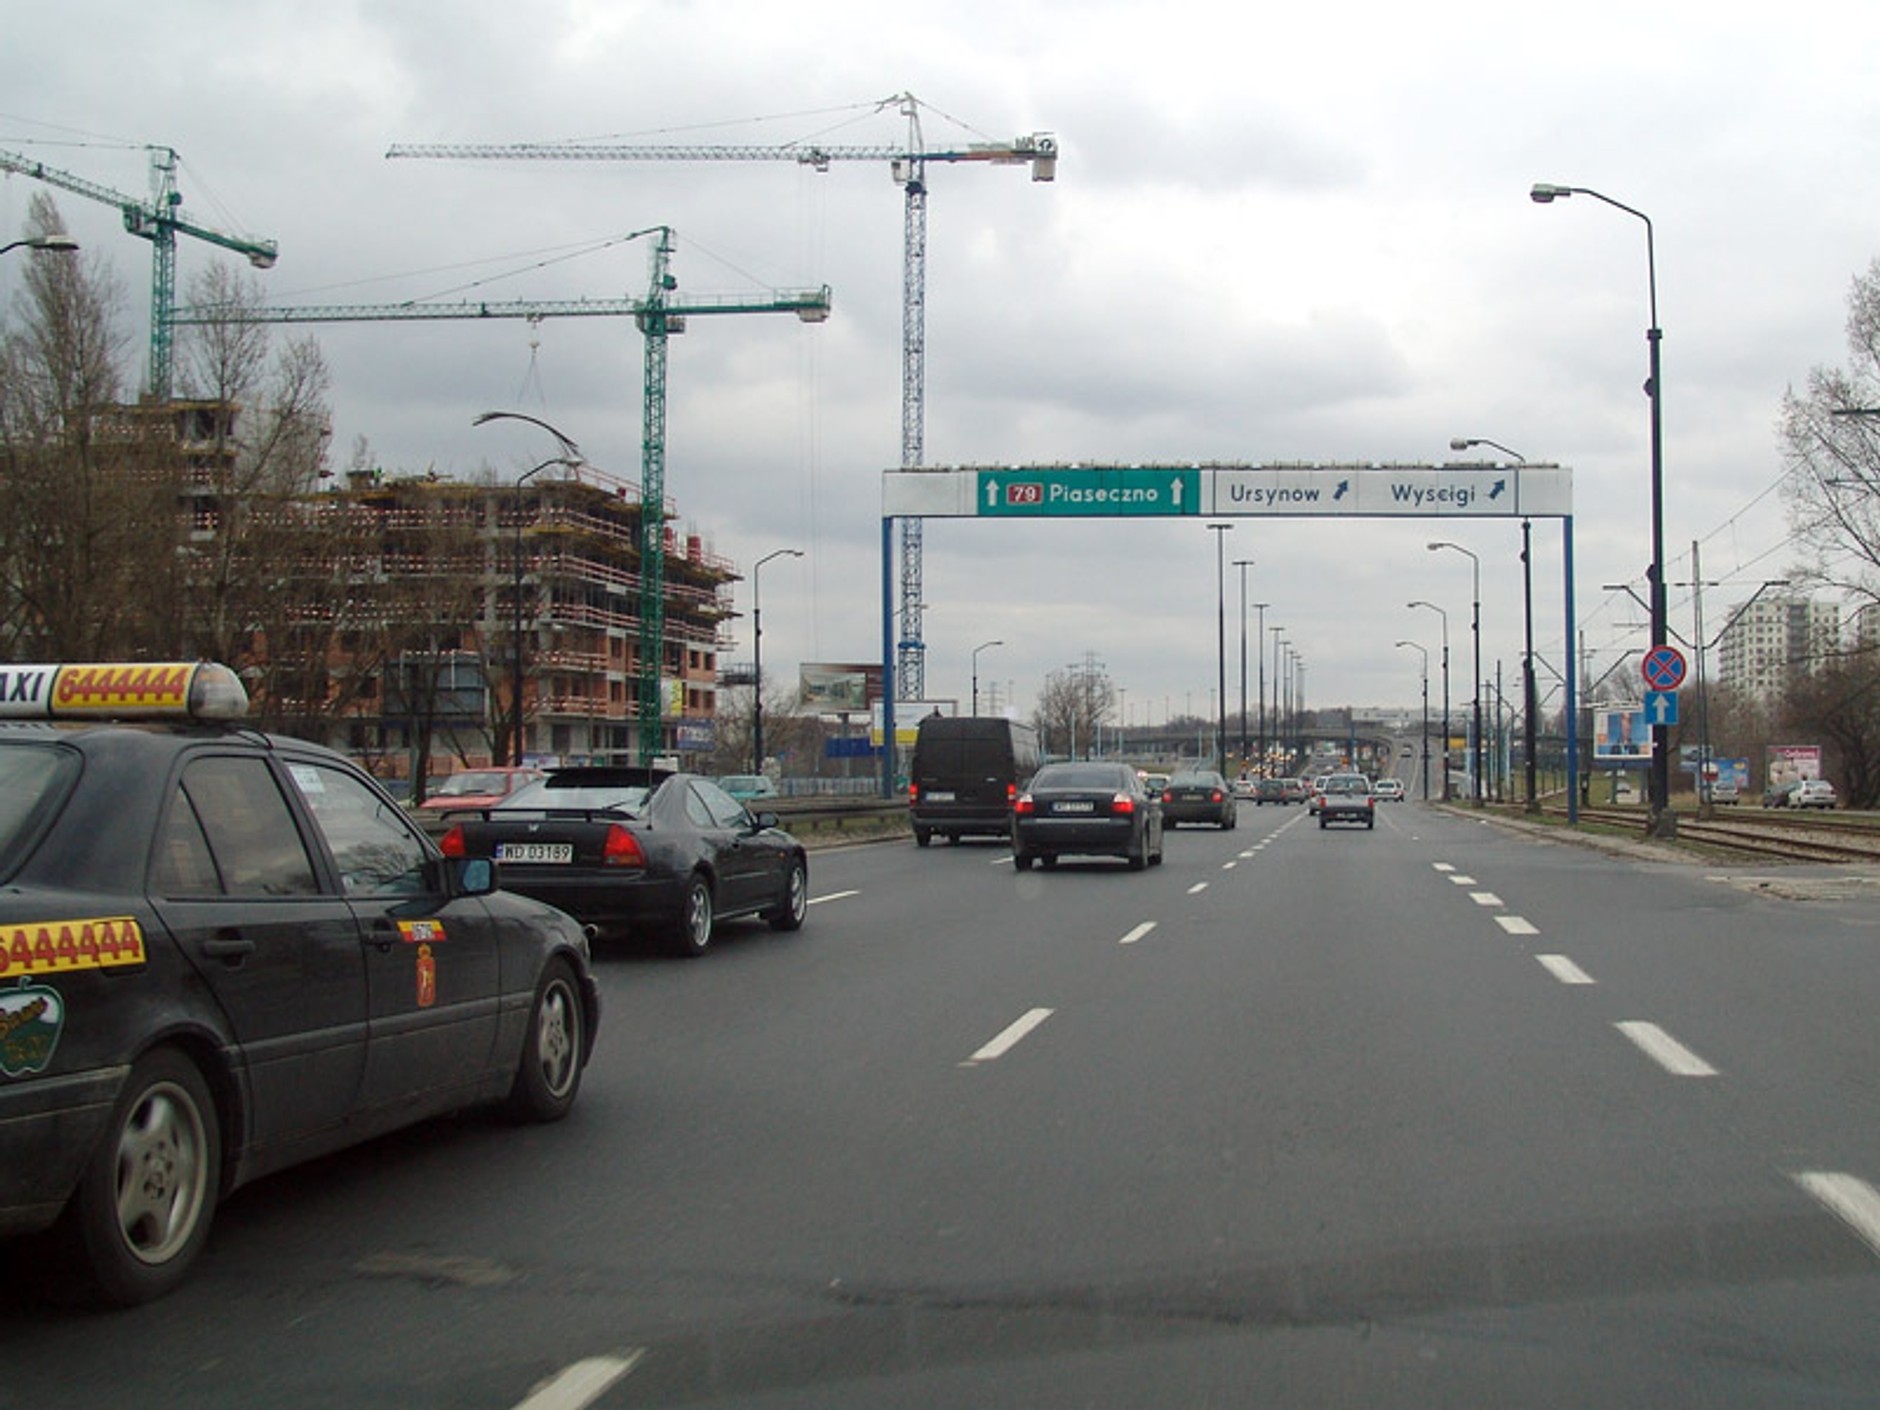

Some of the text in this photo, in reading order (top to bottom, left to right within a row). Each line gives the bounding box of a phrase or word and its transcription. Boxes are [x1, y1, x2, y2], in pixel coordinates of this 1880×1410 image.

[1014, 484, 1158, 502] 79 Piaseczno
[57, 668, 188, 702] 6444444
[505, 846, 525, 859] WD
